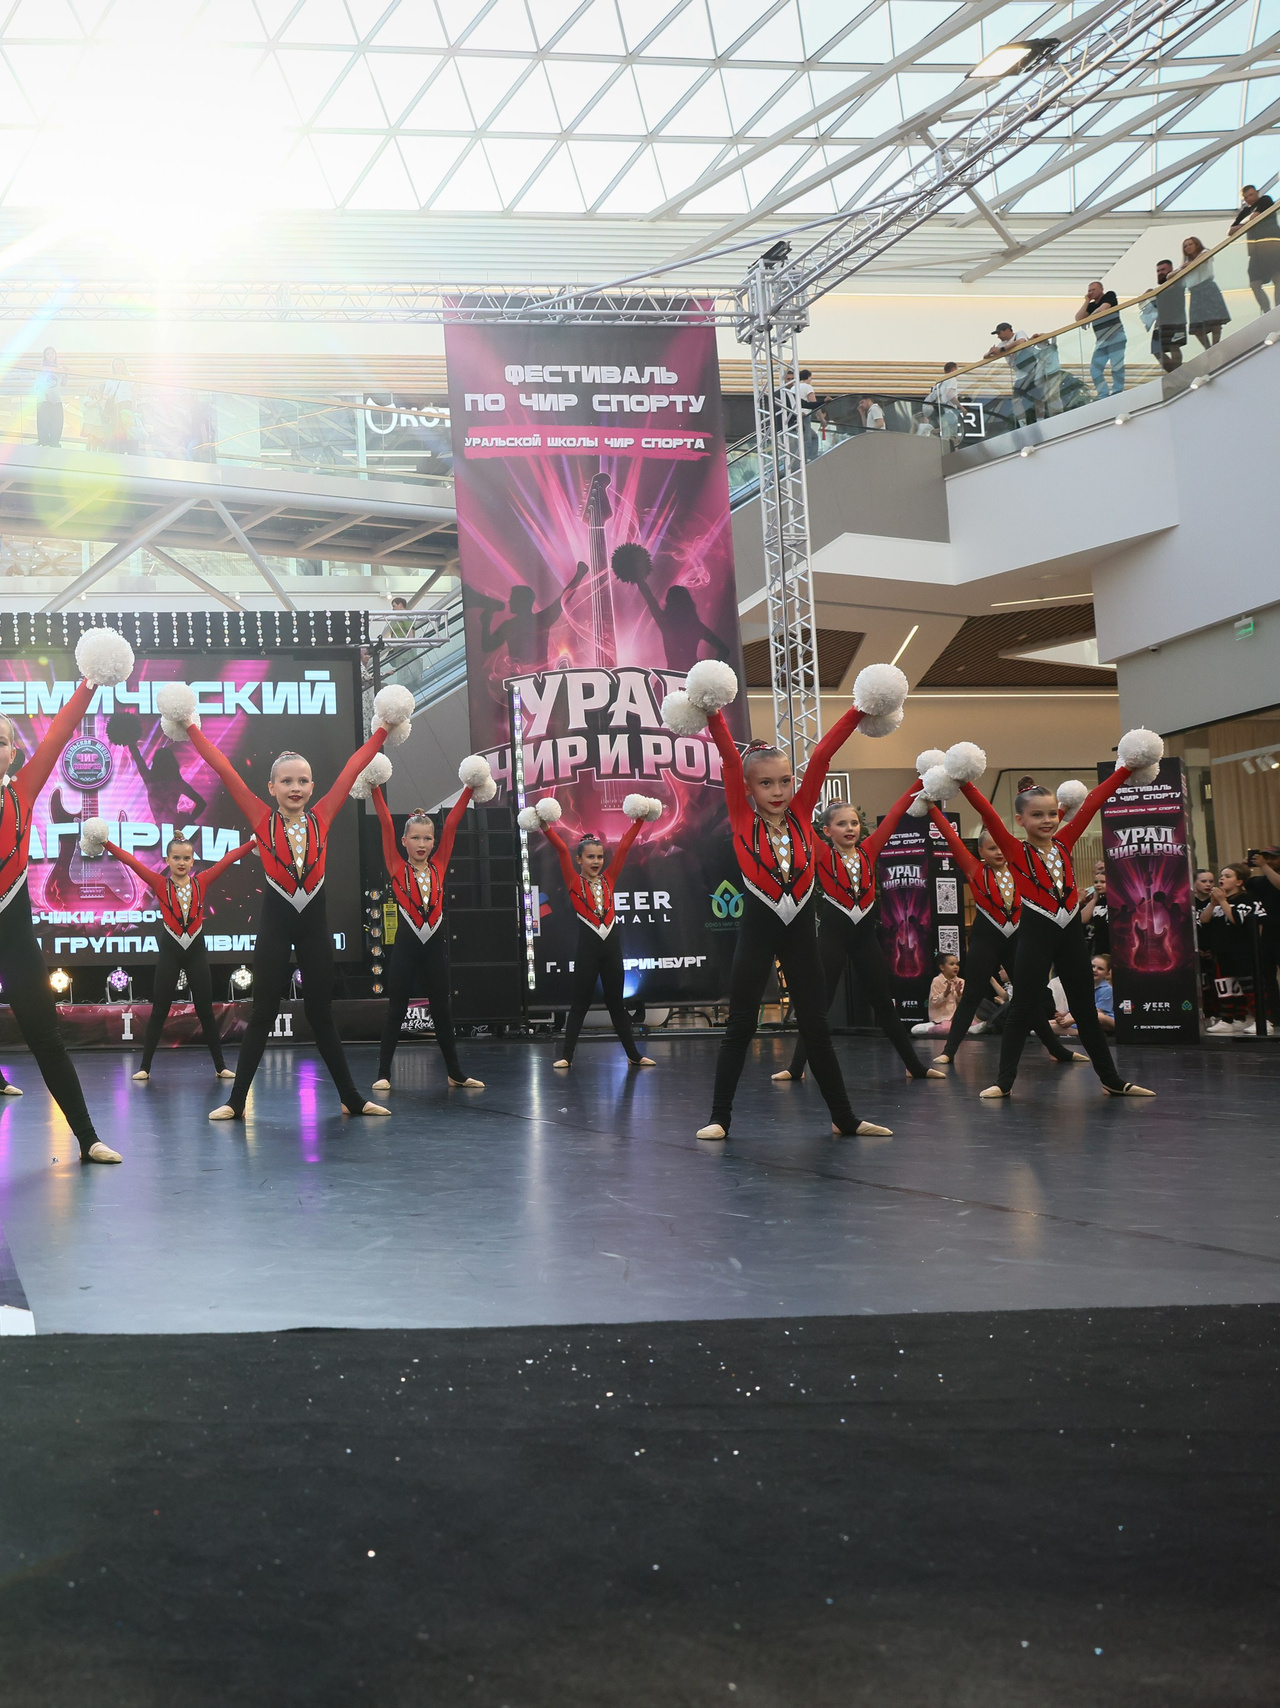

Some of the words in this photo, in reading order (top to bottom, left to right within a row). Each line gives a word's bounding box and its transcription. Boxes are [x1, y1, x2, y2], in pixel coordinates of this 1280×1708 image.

[504, 365, 678, 386] ФЕСТИВАЛЬ
[464, 393, 506, 412] ПО
[519, 394, 579, 412] ЧИР
[592, 394, 706, 413] СПОРТУ
[464, 433, 541, 448] УРАЛЬСКОЙ
[547, 437, 598, 448] ШКОЛЫ
[604, 438, 635, 448] ЧИР
[641, 438, 706, 449] СПОРТА
[507, 670, 713, 738] УРА
[597, 734, 631, 775] И
[1120, 794, 1139, 802] ЧИР
[1143, 792, 1181, 801] СПОРТУ
[1116, 826, 1174, 846] УРАЛ
[1109, 844, 1138, 860] ЧИР
[1141, 843, 1151, 854] И
[1153, 843, 1184, 856] РОК
[887, 865, 921, 880] УРАЛ
[882, 879, 900, 890] ЧИР
[901, 879, 908, 887] И
[908, 879, 926, 888] РОК
[613, 891, 673, 911] EER
[615, 912, 671, 924] MALL
[54, 936, 160, 954] ГРУППА
[404, 1007, 430, 1021] RAL
[1143, 1002, 1170, 1011] YEER
[413, 1019, 436, 1030] Rock
